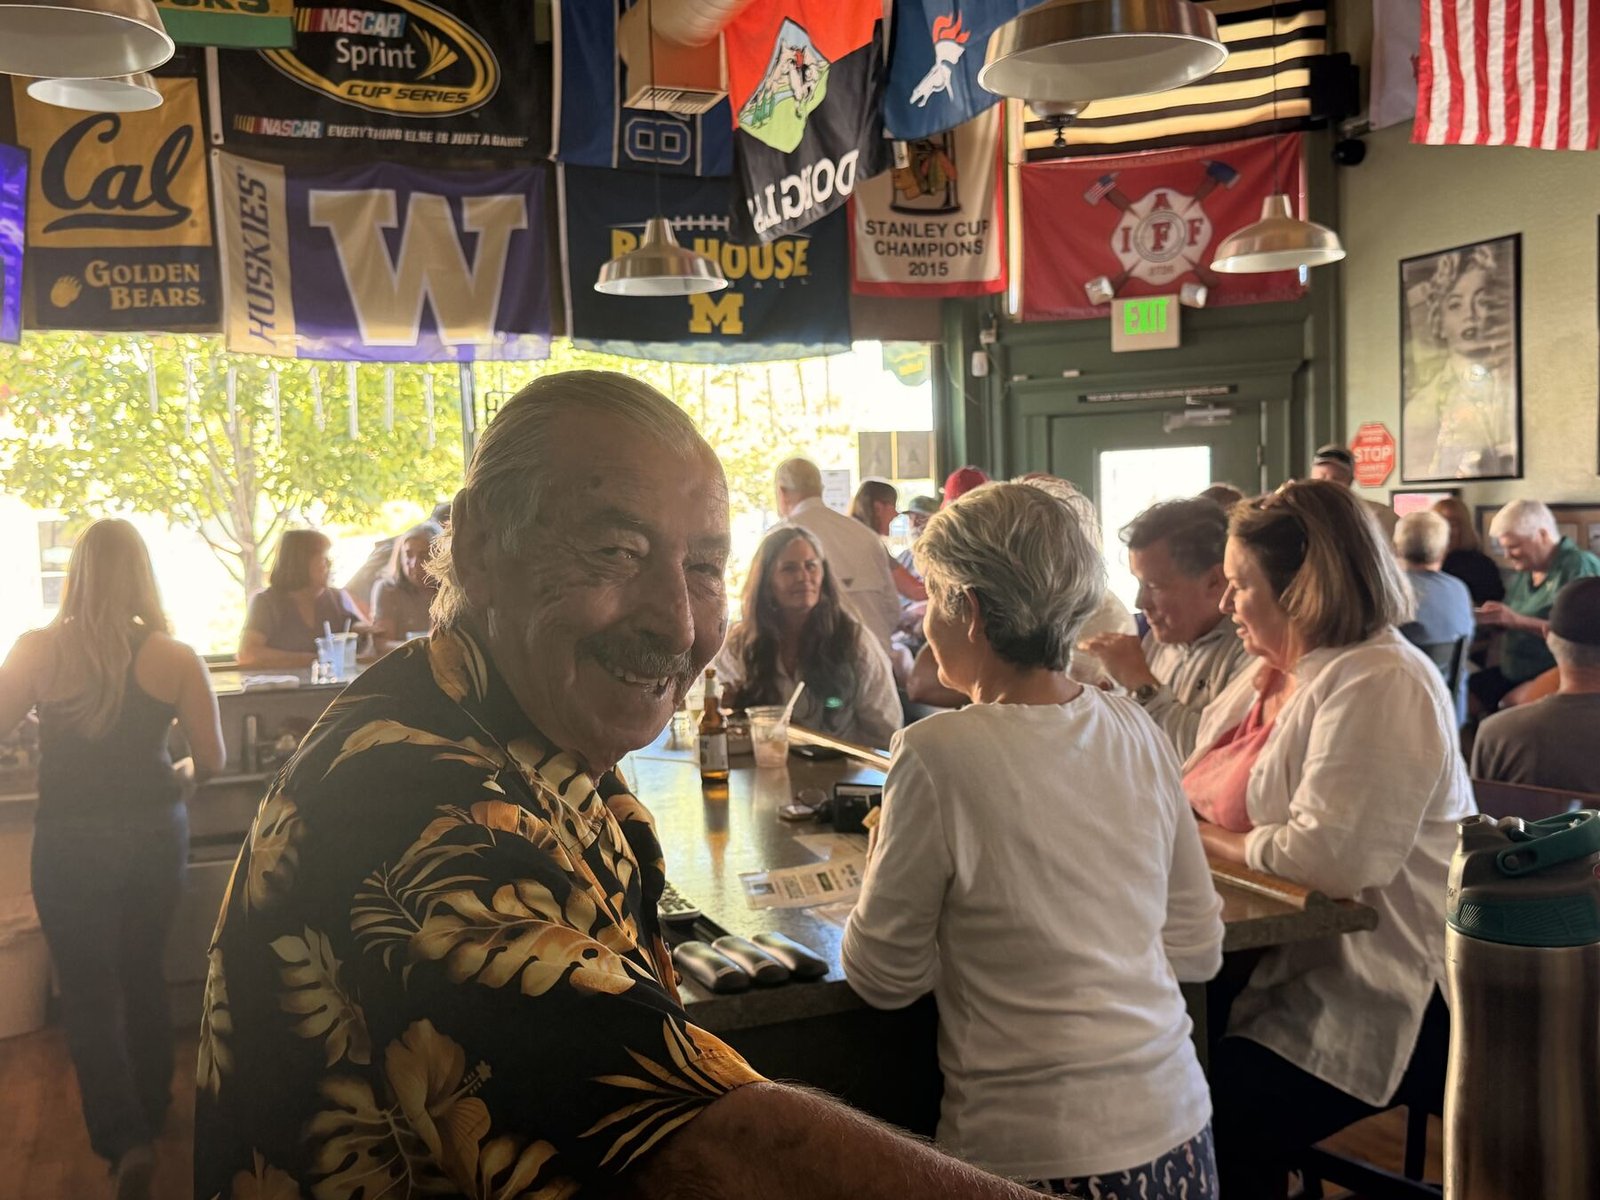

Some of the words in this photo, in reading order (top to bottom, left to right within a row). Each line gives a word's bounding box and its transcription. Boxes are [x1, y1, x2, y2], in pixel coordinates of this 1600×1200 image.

[320, 9, 402, 37] NASCAR
[335, 38, 416, 71] Sprint
[347, 84, 391, 98] CUP
[394, 88, 470, 104] SERIES
[261, 119, 321, 138] NASCAR
[327, 125, 402, 140] EVERYTHING
[404, 129, 433, 143] ELSE
[435, 131, 449, 144] IS
[450, 133, 481, 146] JUST
[481, 133, 491, 146] A
[41, 112, 193, 226] Cal
[865, 219, 948, 238] STANLEY
[238, 177, 278, 348] HUSKIES
[693, 237, 810, 281] HOUSE
[874, 240, 984, 258] CHAMPIONS
[309, 188, 528, 347] W
[908, 261, 949, 277] 2015
[688, 292, 744, 335] M
[1123, 296, 1169, 336] EXIT
[1353, 446, 1393, 463] STOP
